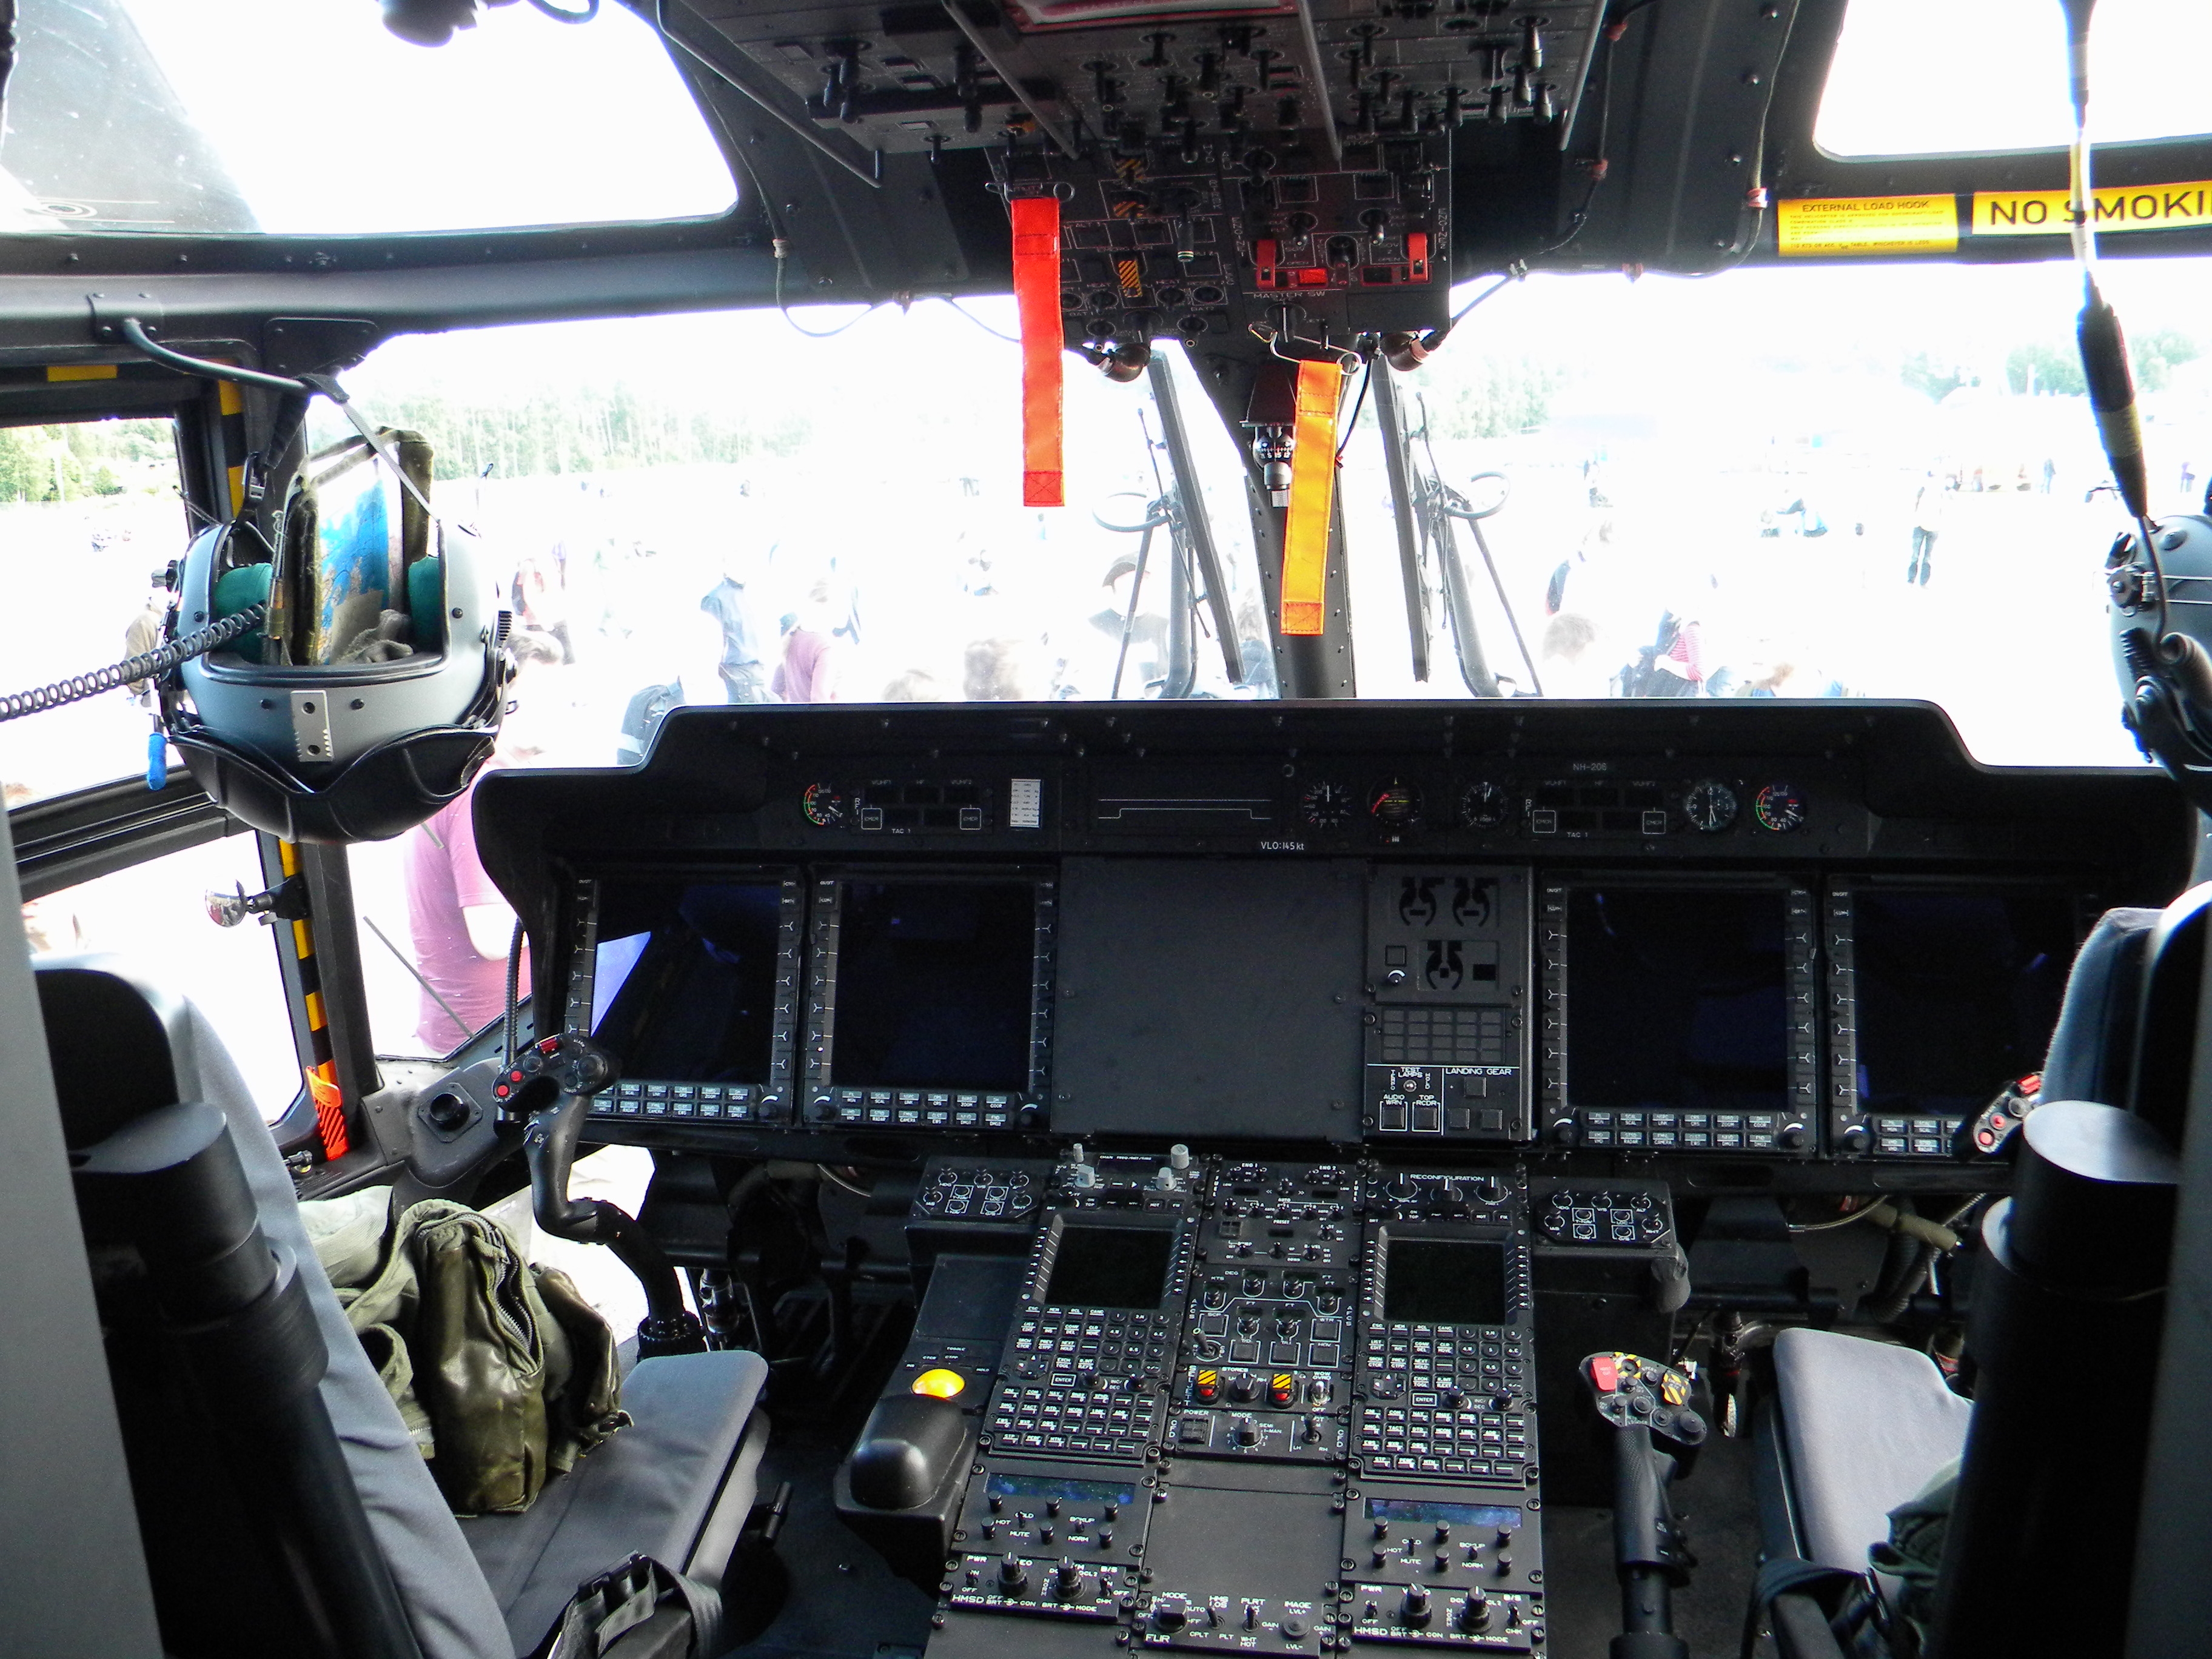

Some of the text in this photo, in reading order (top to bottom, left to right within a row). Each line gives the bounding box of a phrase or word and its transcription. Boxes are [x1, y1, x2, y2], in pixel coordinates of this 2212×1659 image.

[1802, 204, 1862, 212] EXTERNAL
[1897, 200, 1930, 209] HOOK
[1991, 190, 2212, 225] NO SMOKI
[1260, 841, 1305, 851] VLO:145 kt
[1409, 1173, 1484, 1182] RECONFIGURATION
[952, 1594, 985, 1604] HMSD
[1241, 1597, 1265, 1606] PLRT
[1284, 1601, 1312, 1609] IMAGE
[1354, 1626, 1388, 1635] HMSD
[1145, 1634, 1170, 1643] FLIR
